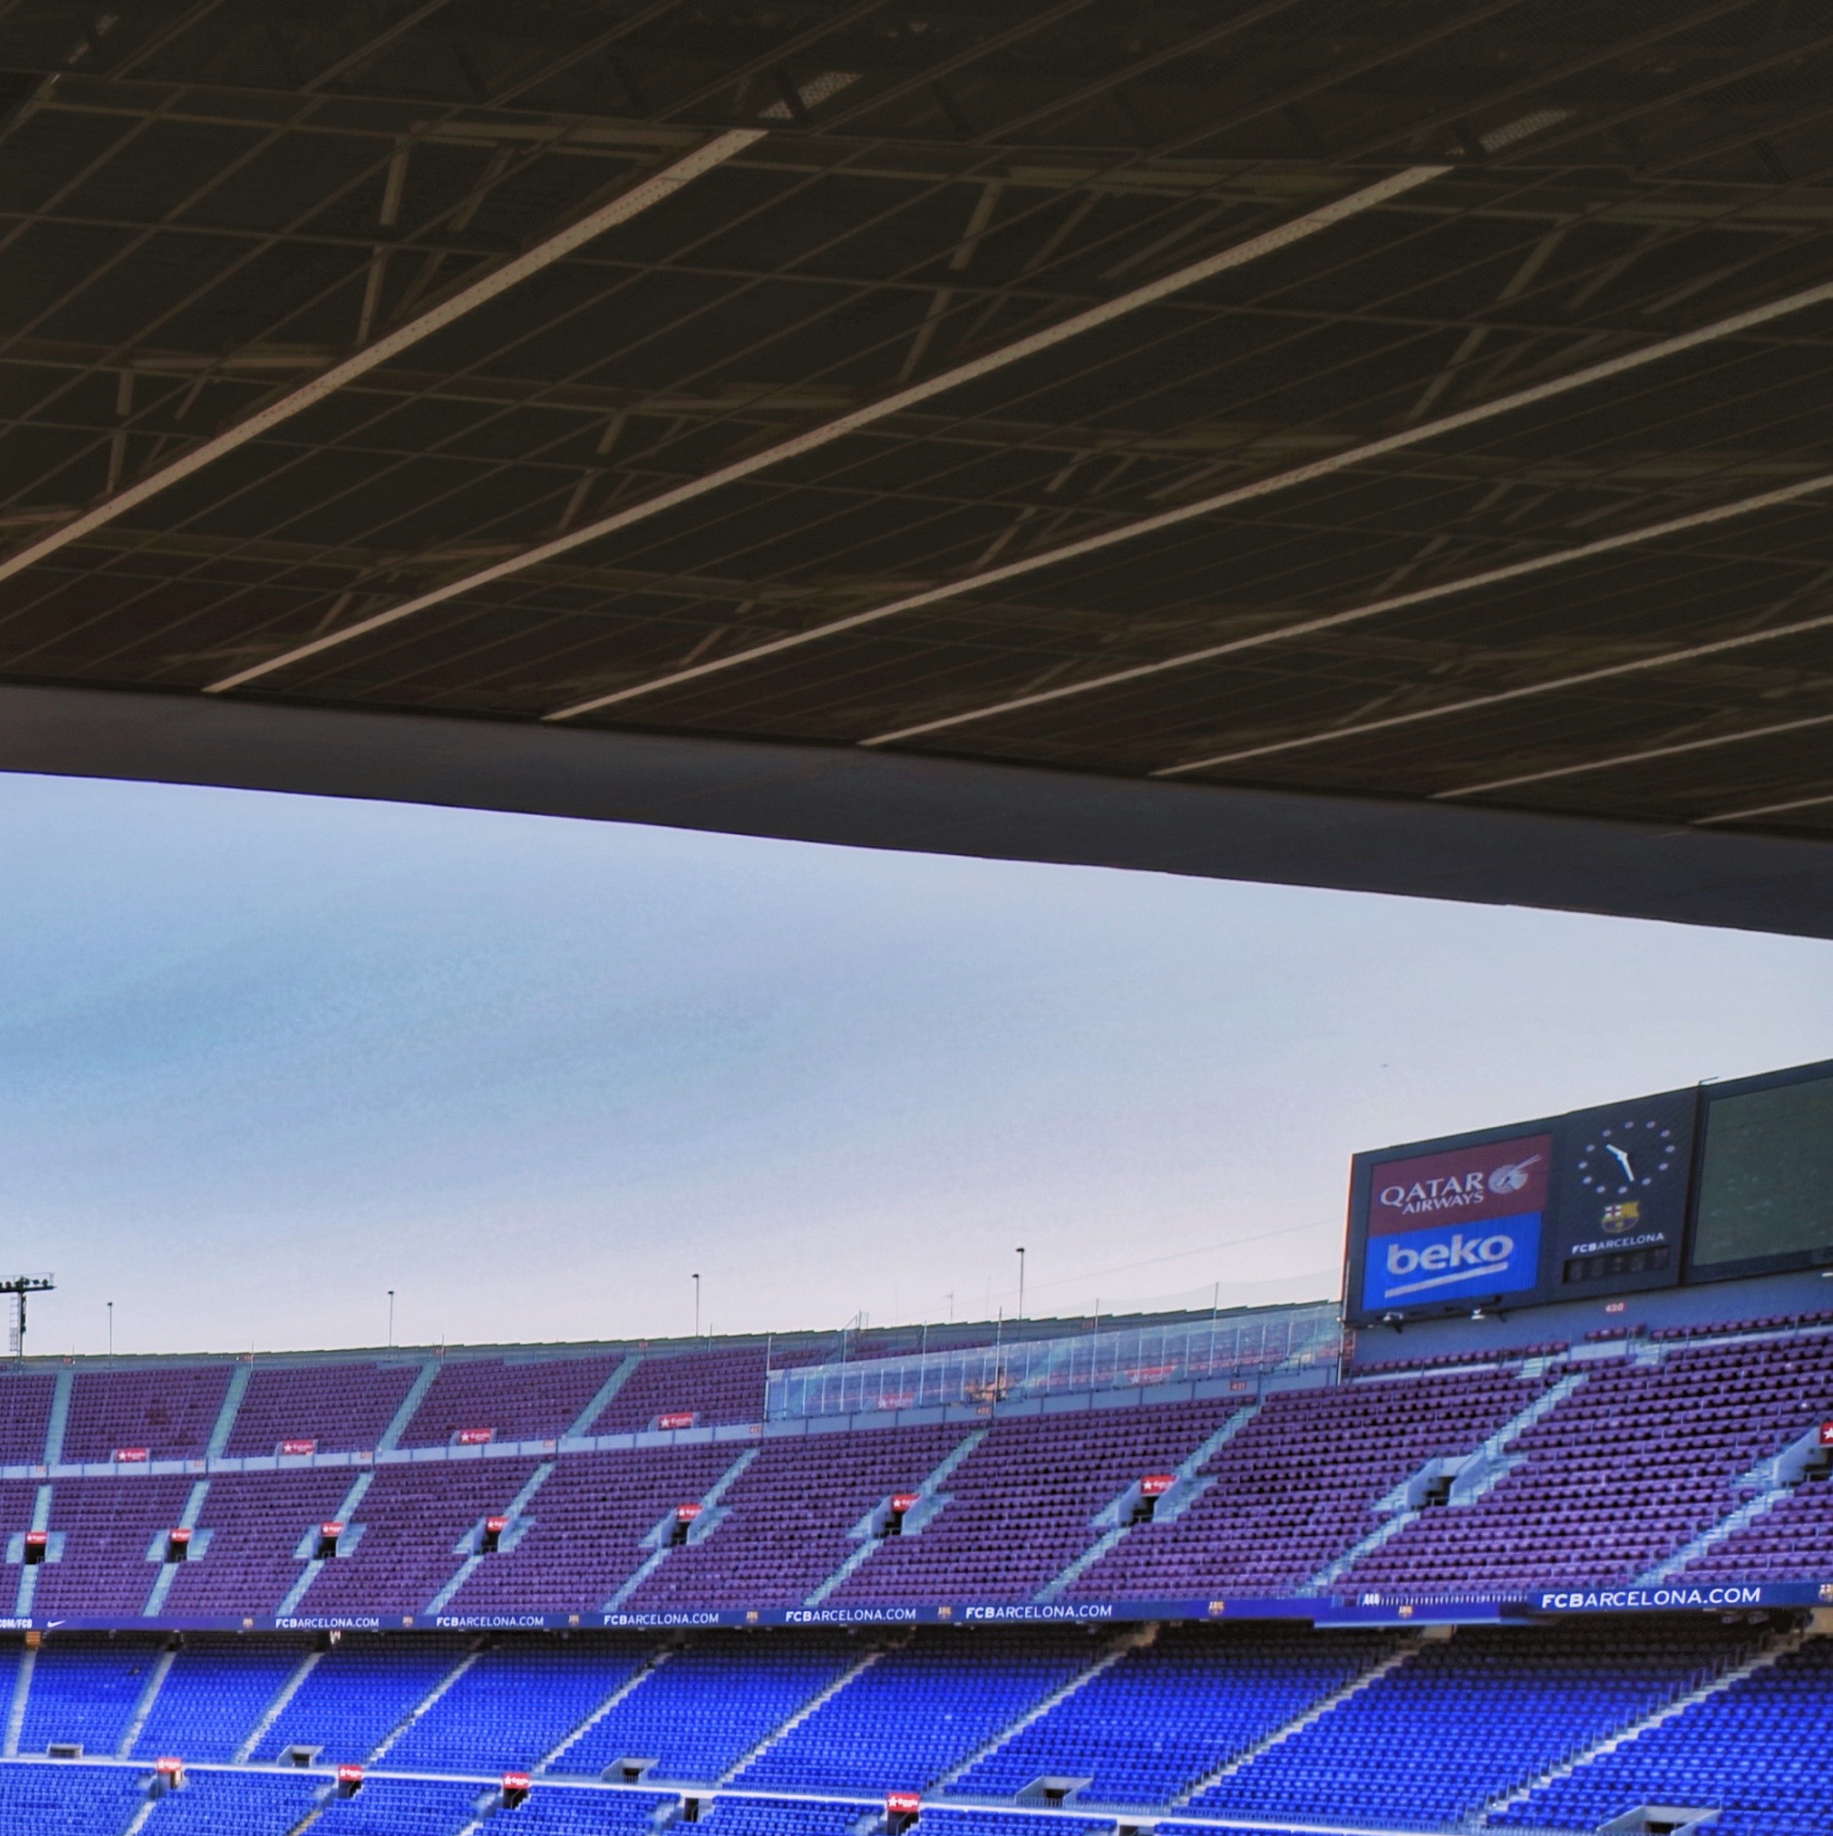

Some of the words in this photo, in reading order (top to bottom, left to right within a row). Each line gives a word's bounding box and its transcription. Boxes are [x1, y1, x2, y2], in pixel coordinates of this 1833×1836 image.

[1381, 1172, 1484, 1207] QATAR
[1402, 1192, 1484, 1215] AIRWAYS
[1572, 1232, 1665, 1253] FCBARCELONA
[1387, 1234, 1514, 1275] beko
[1541, 1587, 1761, 1609] FCBARCELONA.COM
[604, 1612, 719, 1625] FCBARCELONA.COM
[785, 1607, 916, 1622] FCBARCELONA.COM
[965, 1604, 1112, 1619] FCBARCELONA.COM
[275, 1616, 379, 1628] FCBARCELONA.COM
[436, 1615, 543, 1627] FCBARCELONA.COM
